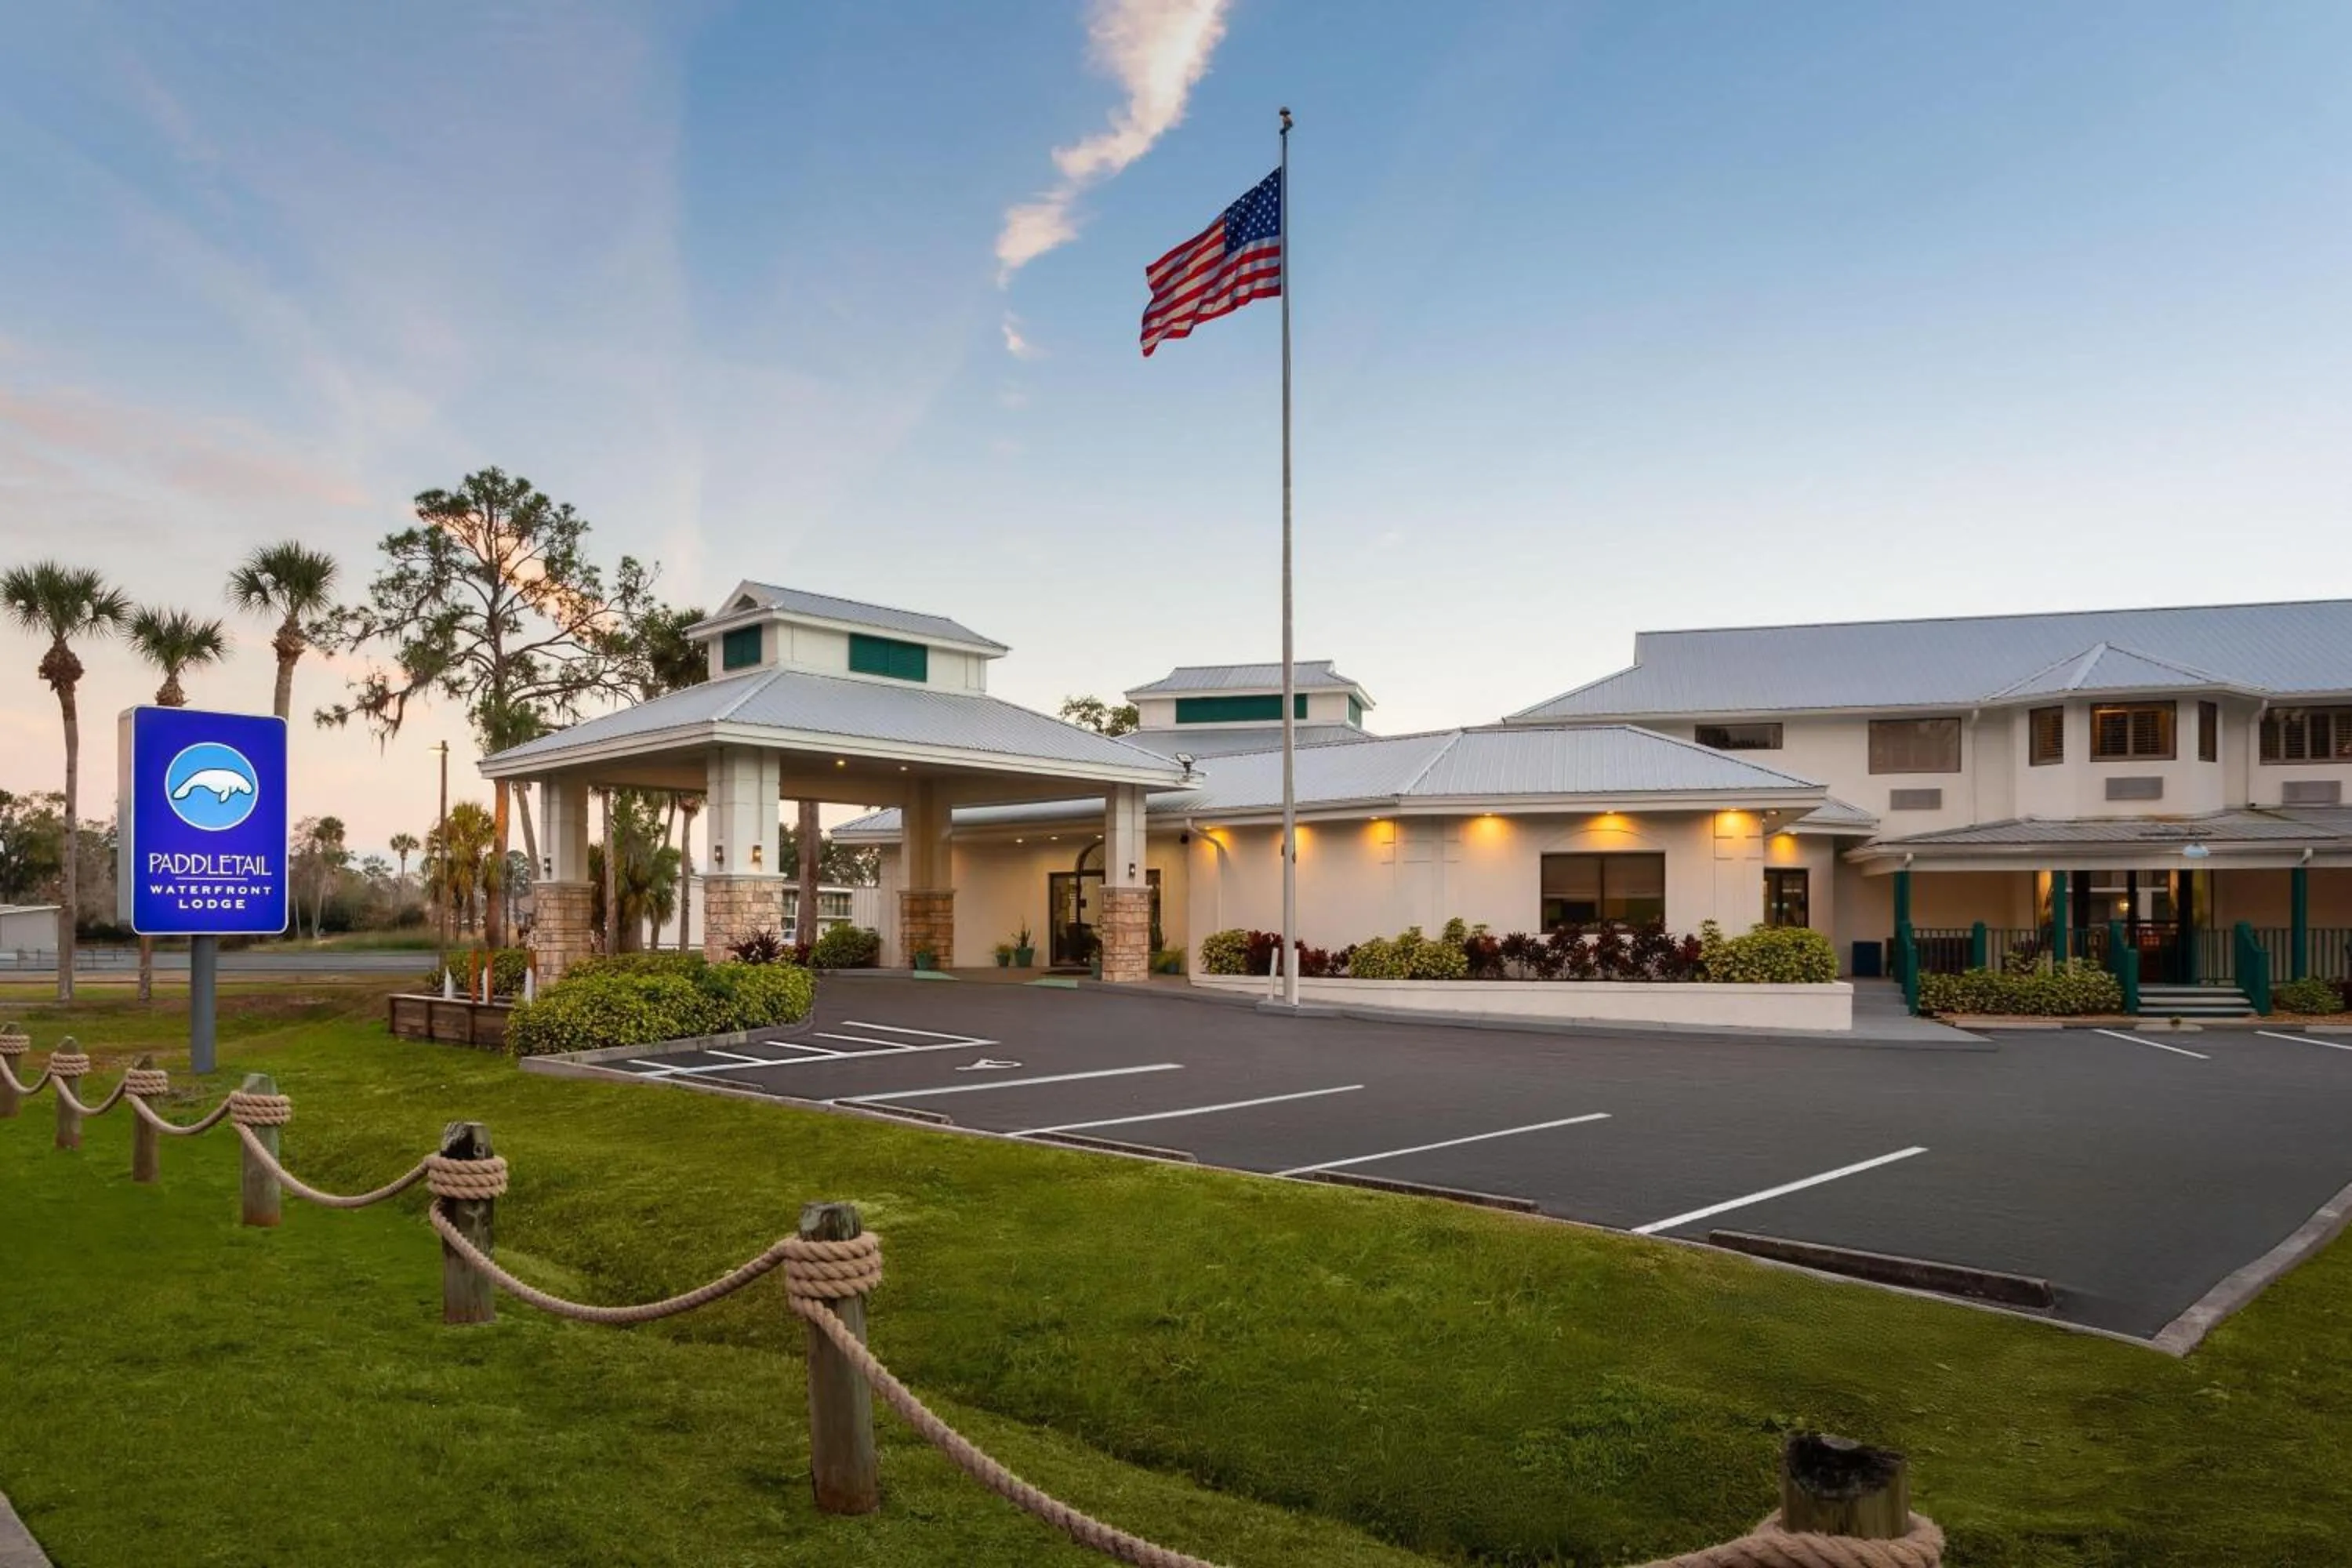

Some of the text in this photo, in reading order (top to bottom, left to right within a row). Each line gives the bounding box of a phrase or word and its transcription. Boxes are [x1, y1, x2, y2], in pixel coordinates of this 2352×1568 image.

[148, 852, 272, 876] PADDLETAIL
[150, 884, 272, 895] WATERFRONT
[179, 899, 246, 909] LODGE
